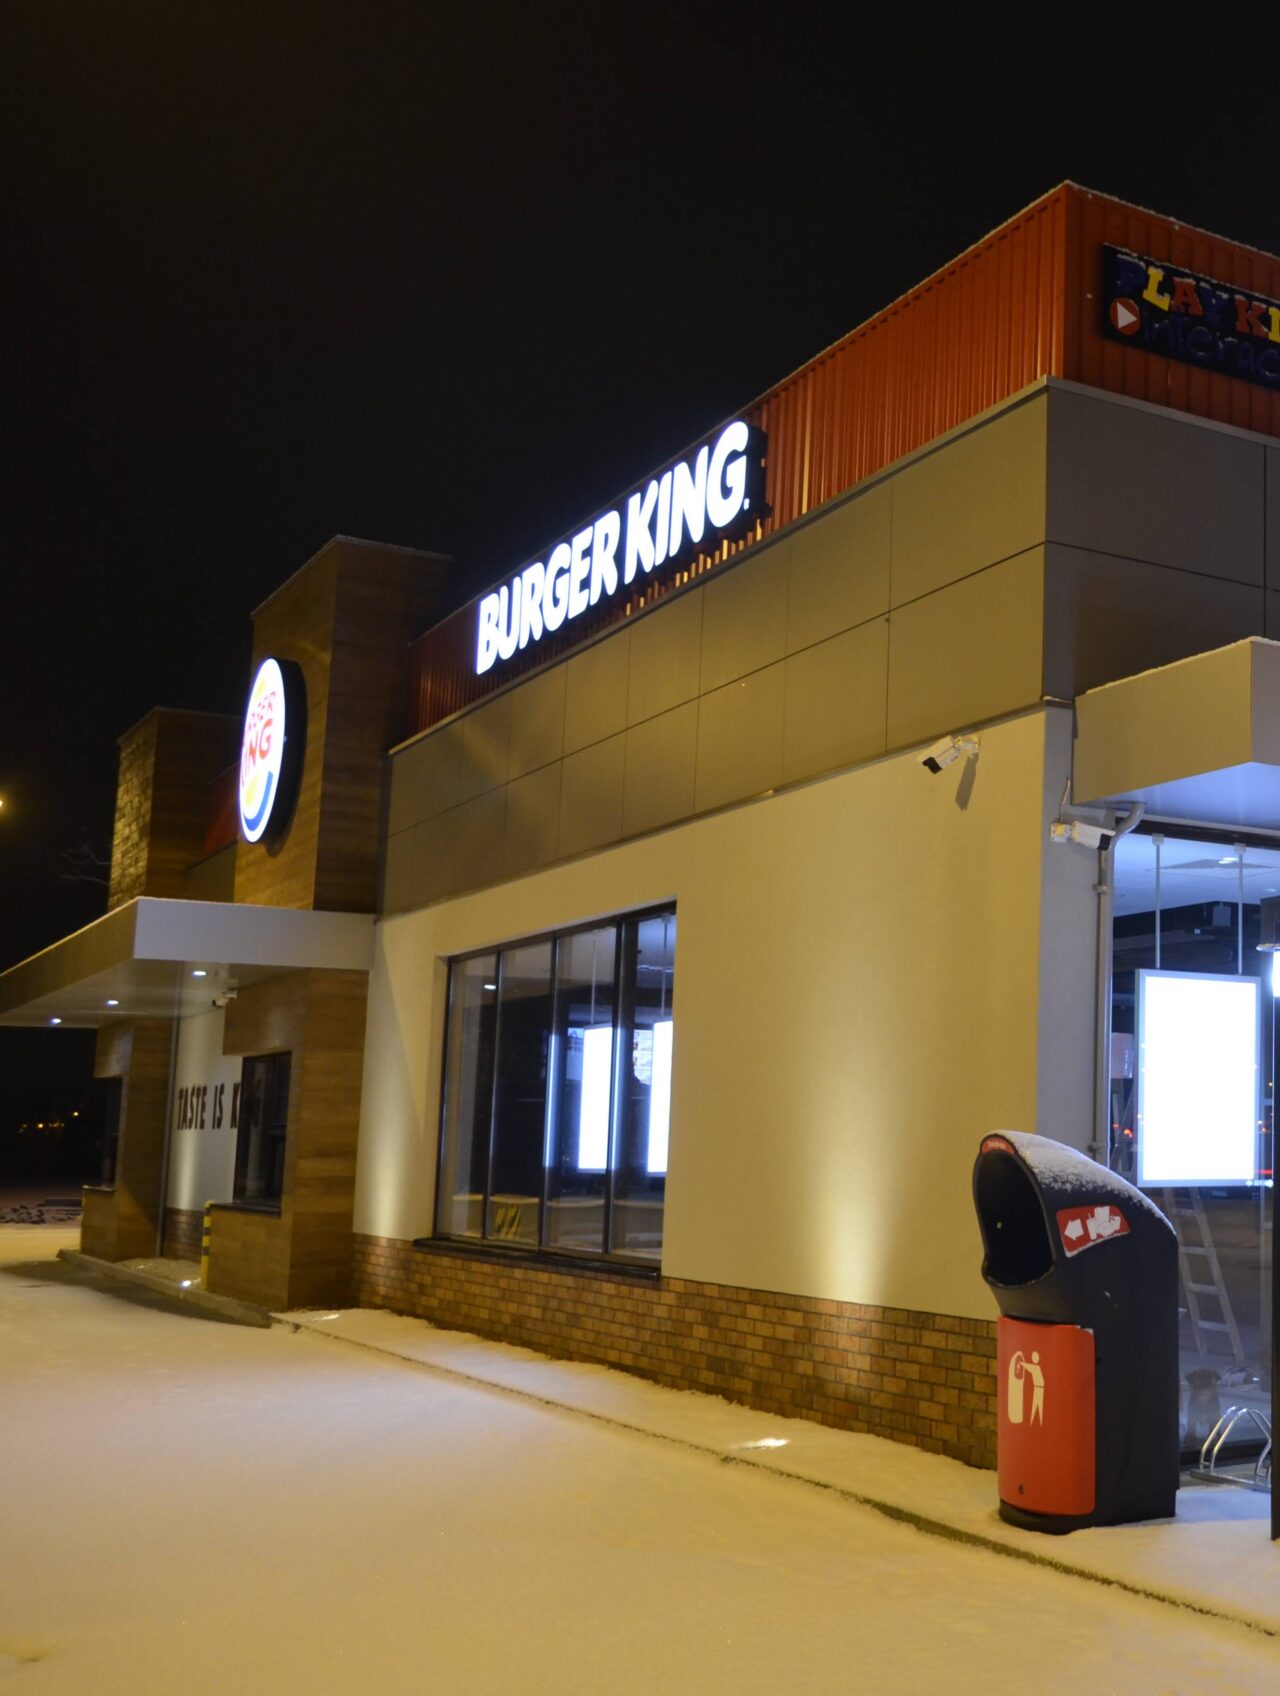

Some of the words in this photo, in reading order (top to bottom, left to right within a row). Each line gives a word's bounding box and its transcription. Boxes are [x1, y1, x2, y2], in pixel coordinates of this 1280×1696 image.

[476, 510, 621, 675] BURGER
[624, 421, 749, 584] KING
[177, 1086, 208, 1131] TASTE
[212, 1082, 225, 1131] IS
